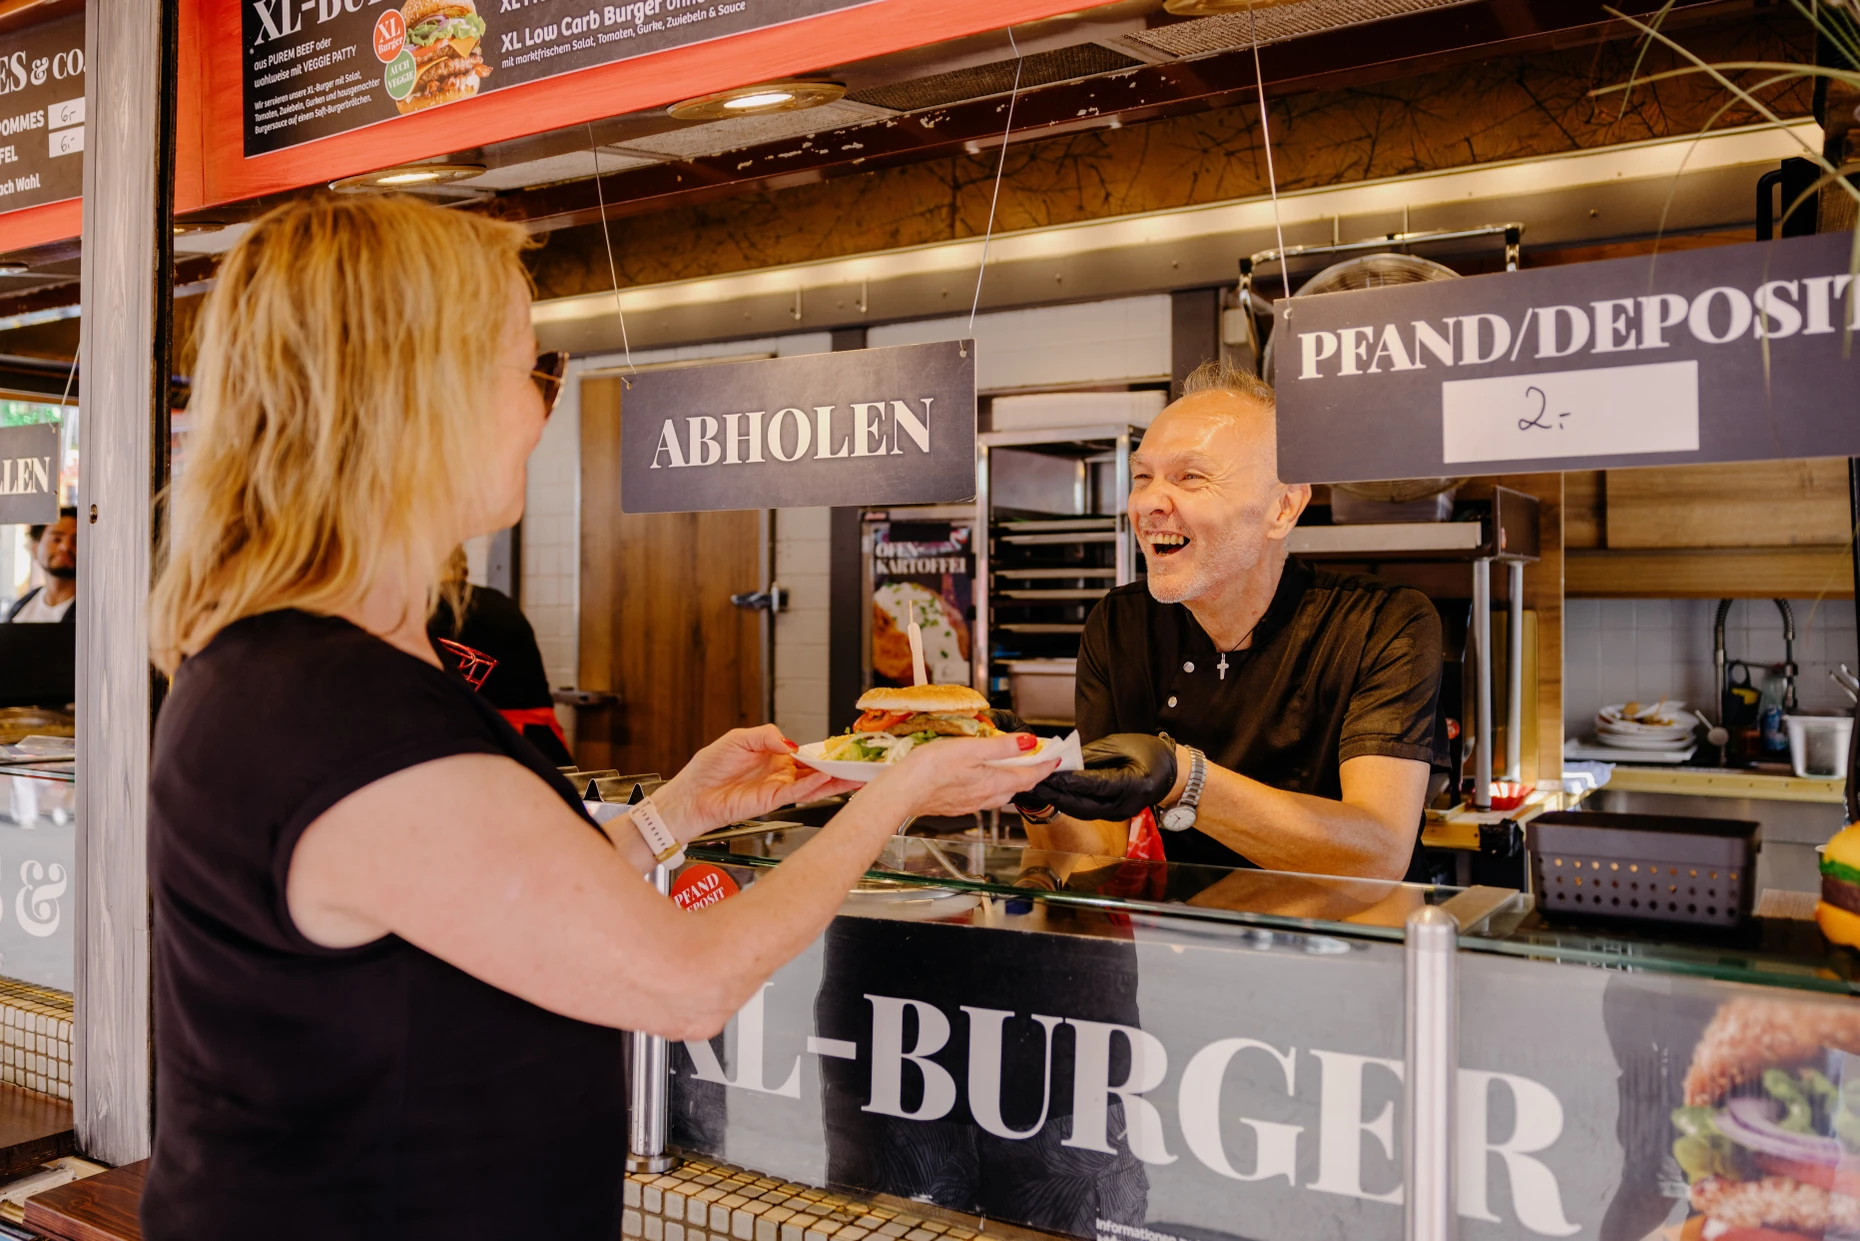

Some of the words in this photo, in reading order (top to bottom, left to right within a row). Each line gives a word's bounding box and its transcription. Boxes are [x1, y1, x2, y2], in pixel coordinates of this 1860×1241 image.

[253, 0, 384, 46] XL-
[378, 17, 401, 44] XL
[501, 31, 522, 53] XL
[525, 24, 558, 47] Low
[561, 10, 600, 37] Carb
[603, 0, 661, 26] Burger
[501, 56, 514, 69] mit
[515, 43, 571, 62] marktfrischem
[572, 37, 596, 51] Salat,
[597, 27, 636, 45] Tomaten,
[636, 19, 666, 35] Gurke,
[666, 8, 707, 28] Zwiebeln
[708, 6, 717, 17] &
[718, 1, 746, 16] Sauce
[254, 59, 267, 71] aus
[268, 47, 295, 67] PUREM
[296, 40, 315, 57] BEEF
[315, 38, 332, 51] oder
[377, 35, 403, 55] Burger
[30, 56, 49, 86] &
[254, 69, 290, 88] wahlweise
[290, 64, 302, 77] mit
[302, 53, 331, 73] VEGGIE
[332, 44, 357, 64] PATTY
[387, 70, 414, 90] VEGGIE
[389, 59, 410, 77] AUCH
[307, 80, 335, 95] XL-Burger
[0, 109, 45, 137] OMMES
[15, 172, 41, 192] Wahl
[1297, 272, 1860, 380] PFAND/DEPOSIT
[650, 397, 935, 469] ABHOLEN
[0, 456, 51, 495] LEN
[15, 859, 67, 938] &
[673, 872, 720, 909] PFAND
[685, 885, 726, 913] EPOSIT
